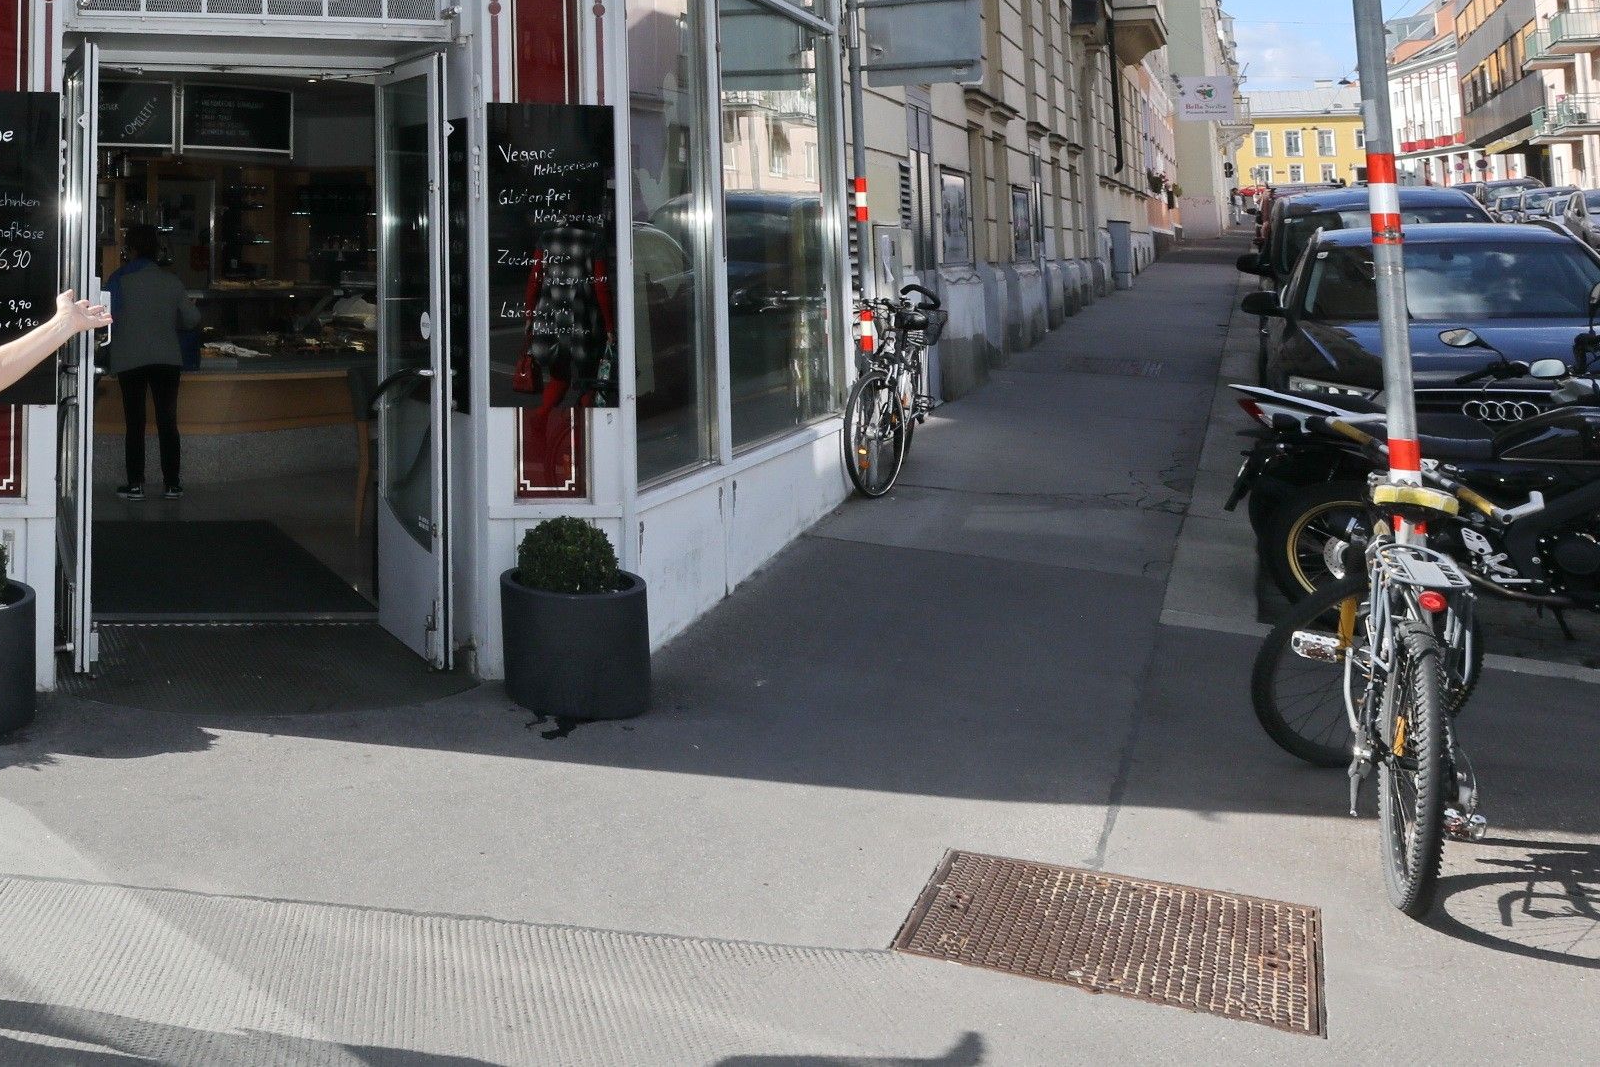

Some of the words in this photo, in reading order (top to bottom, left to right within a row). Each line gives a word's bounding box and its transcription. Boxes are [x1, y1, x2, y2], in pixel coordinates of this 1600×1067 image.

[498, 144, 556, 167] Vegane
[8, 299, 33, 313] 3,90
[15, 317, 40, 330] 1,30
